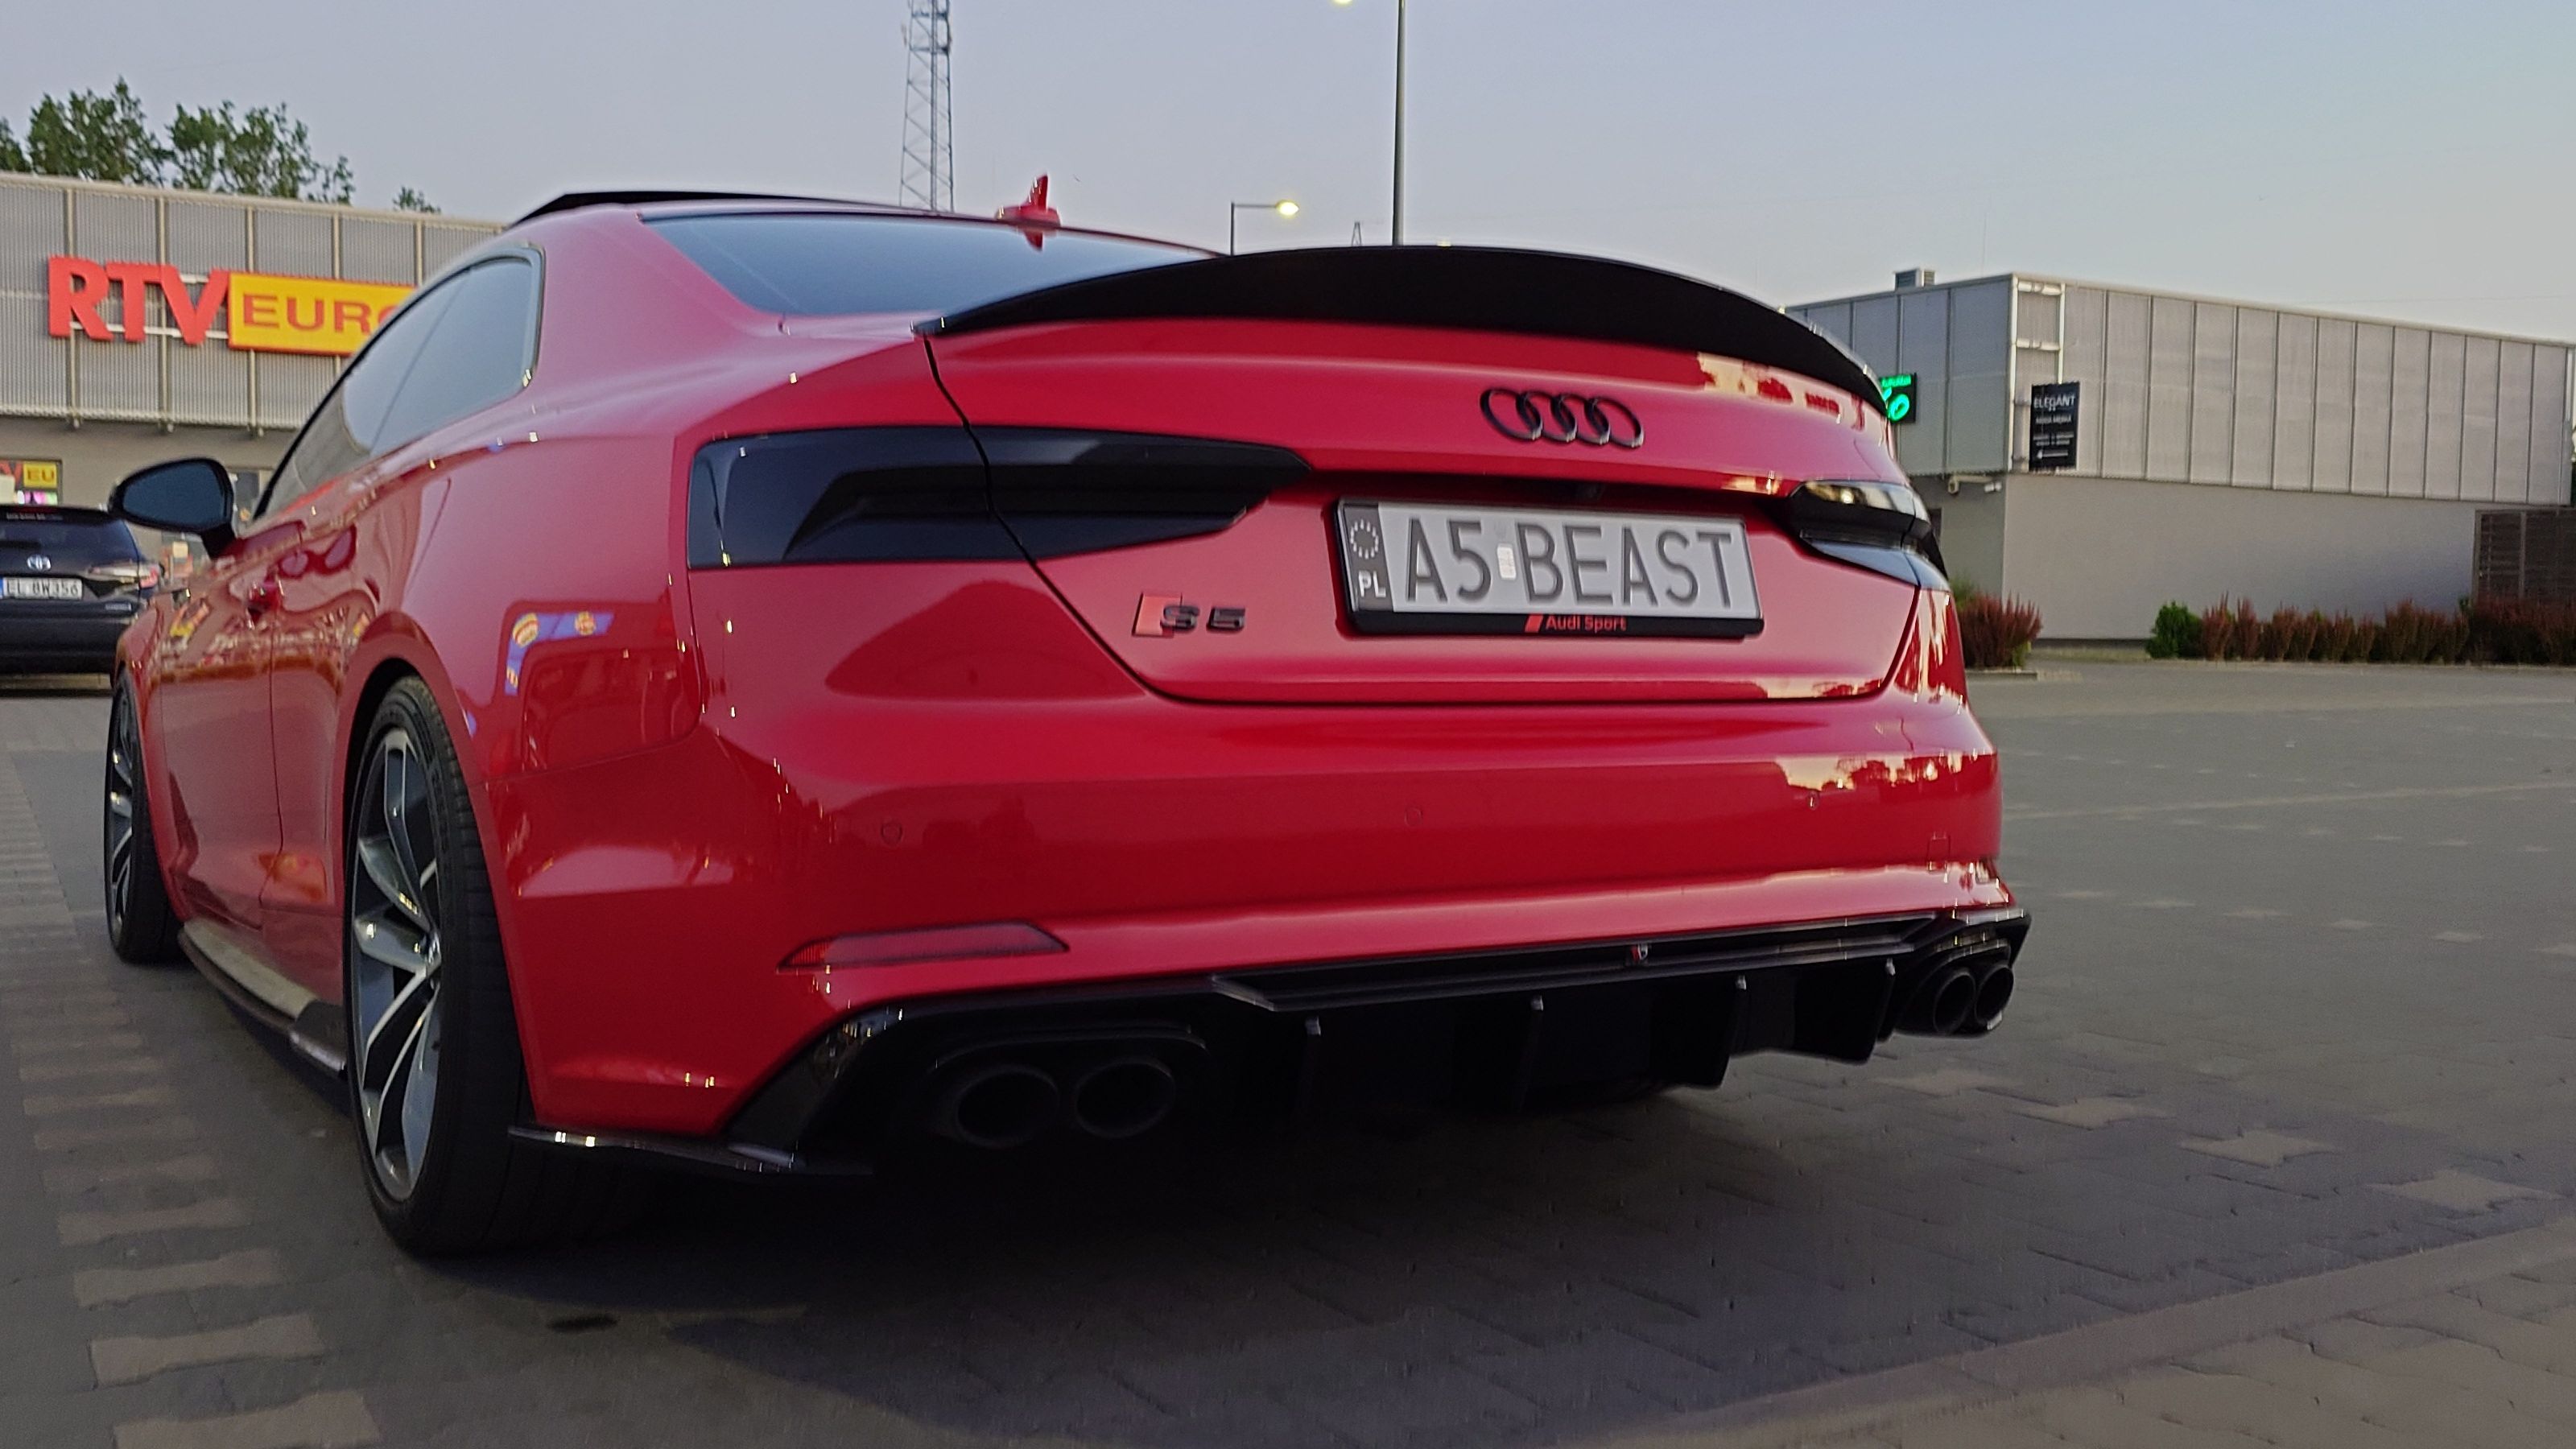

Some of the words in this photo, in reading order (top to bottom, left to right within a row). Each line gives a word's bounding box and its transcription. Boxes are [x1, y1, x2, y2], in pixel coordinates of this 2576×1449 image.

[47, 254, 232, 345] RTV
[2033, 394, 2075, 411] ELEGANT
[1406, 518, 1492, 604] A5
[1516, 522, 1732, 609] BEAST
[1358, 571, 1387, 600] PL
[1159, 605, 1246, 632] S5
[1546, 614, 1581, 630] Audi
[1584, 614, 1626, 634] Sport
